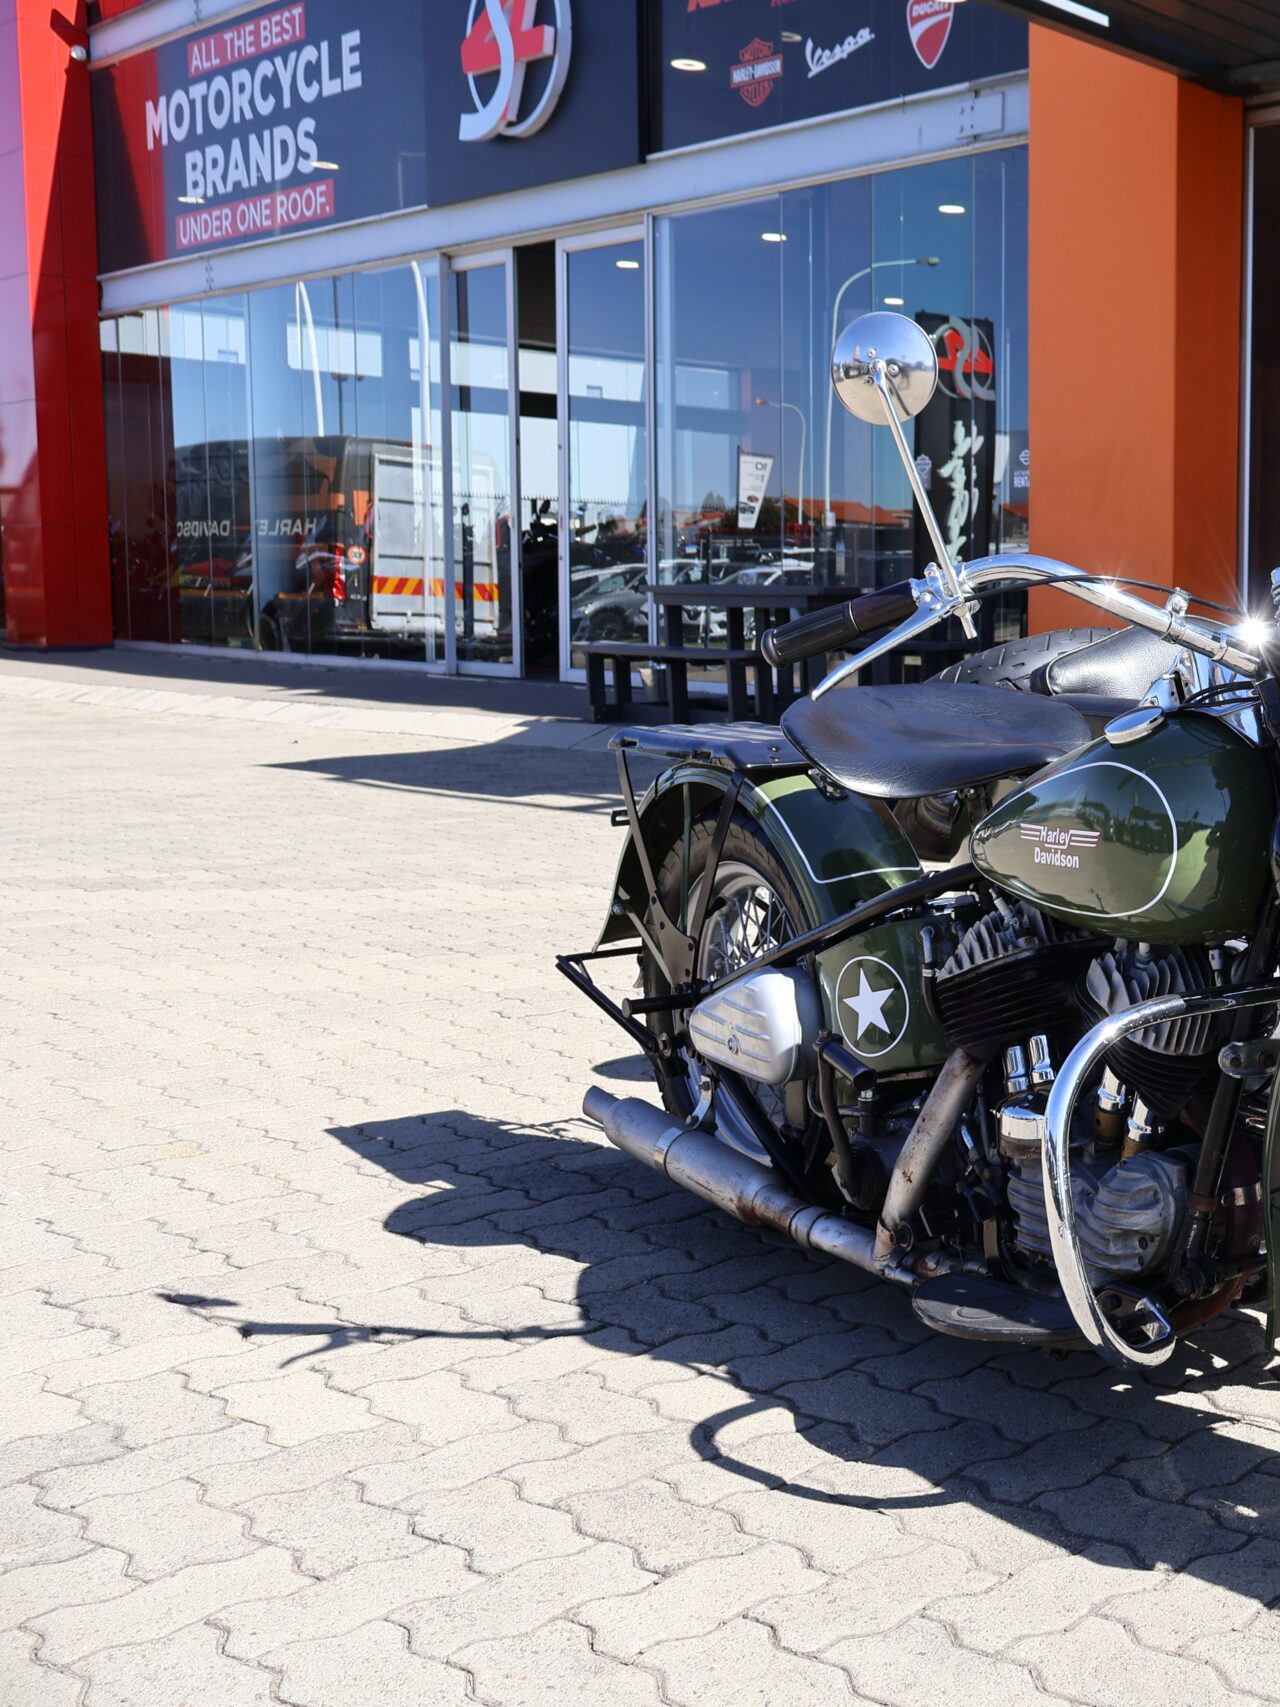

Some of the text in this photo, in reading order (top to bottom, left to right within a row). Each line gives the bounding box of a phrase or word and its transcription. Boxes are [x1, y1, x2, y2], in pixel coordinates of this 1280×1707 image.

[911, 2, 950, 17] DUCATI
[191, 7, 303, 74] ALL THE BEST
[805, 27, 875, 78] Vespa
[145, 29, 363, 151] MOTORCYCLE
[732, 57, 782, 84] HARLEY-DAVIDSON
[185, 117, 318, 200] BRANDS
[179, 184, 330, 245] UNDER ONE ROOF.
[1034, 847, 1080, 868] Davidson
[1040, 826, 1072, 849] Harley
